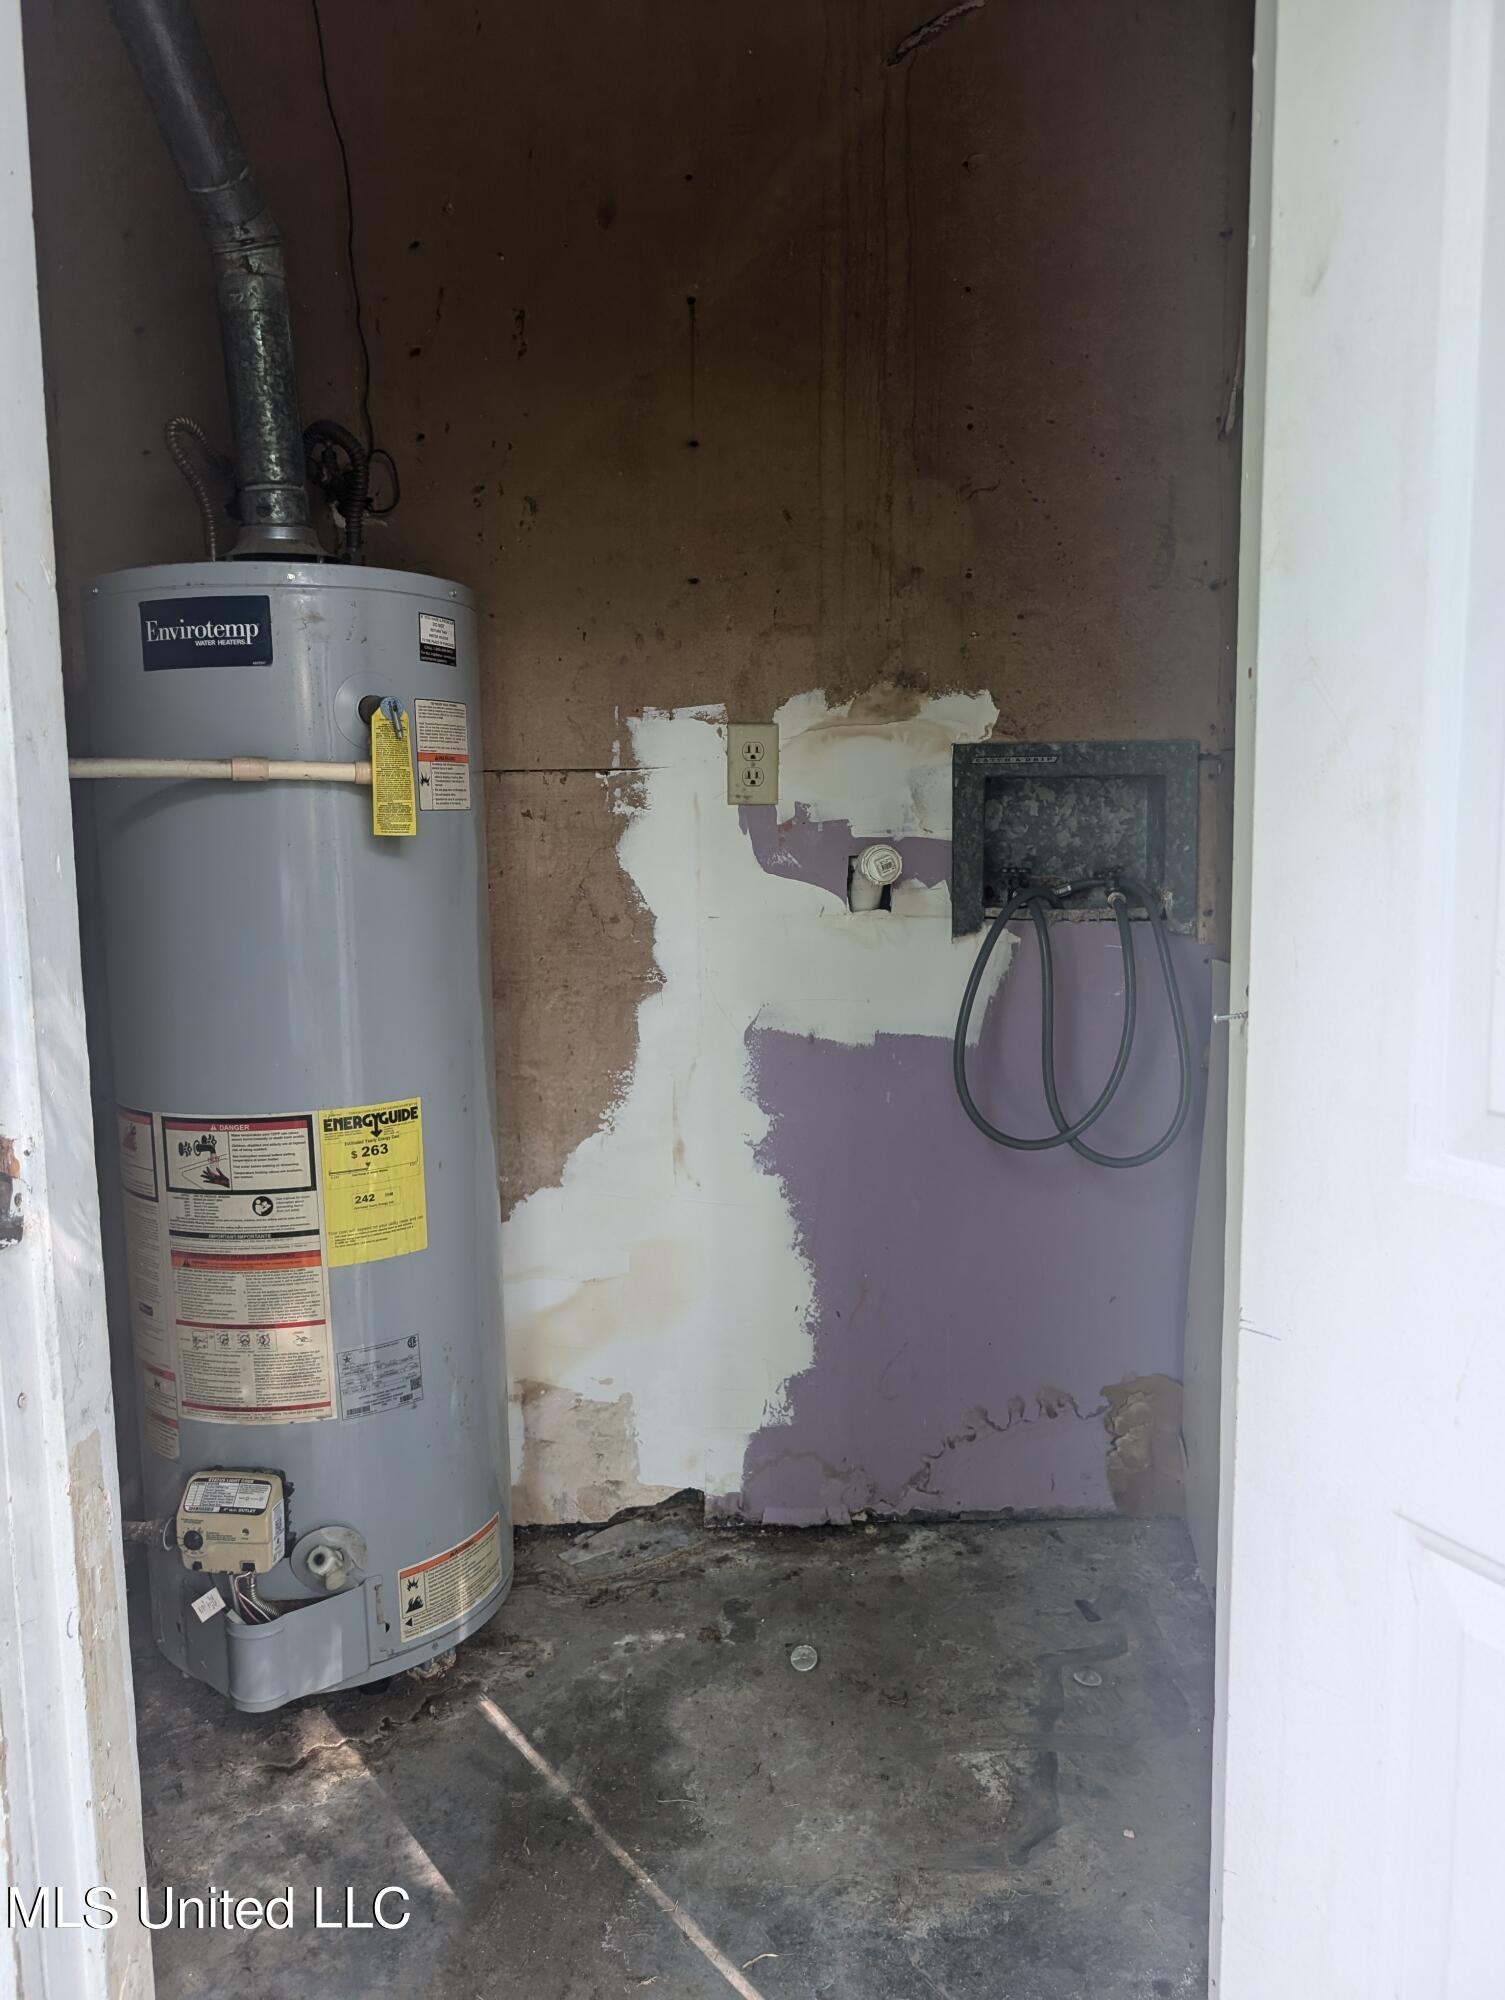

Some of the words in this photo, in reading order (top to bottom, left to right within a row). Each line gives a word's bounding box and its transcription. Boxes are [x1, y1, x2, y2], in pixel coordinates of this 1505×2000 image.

[145, 618, 259, 645] Envirotemp
[323, 1106, 418, 1132] ENERGYGUIDE
[361, 1143, 389, 1158] 263
[354, 1193, 375, 1204] 242
